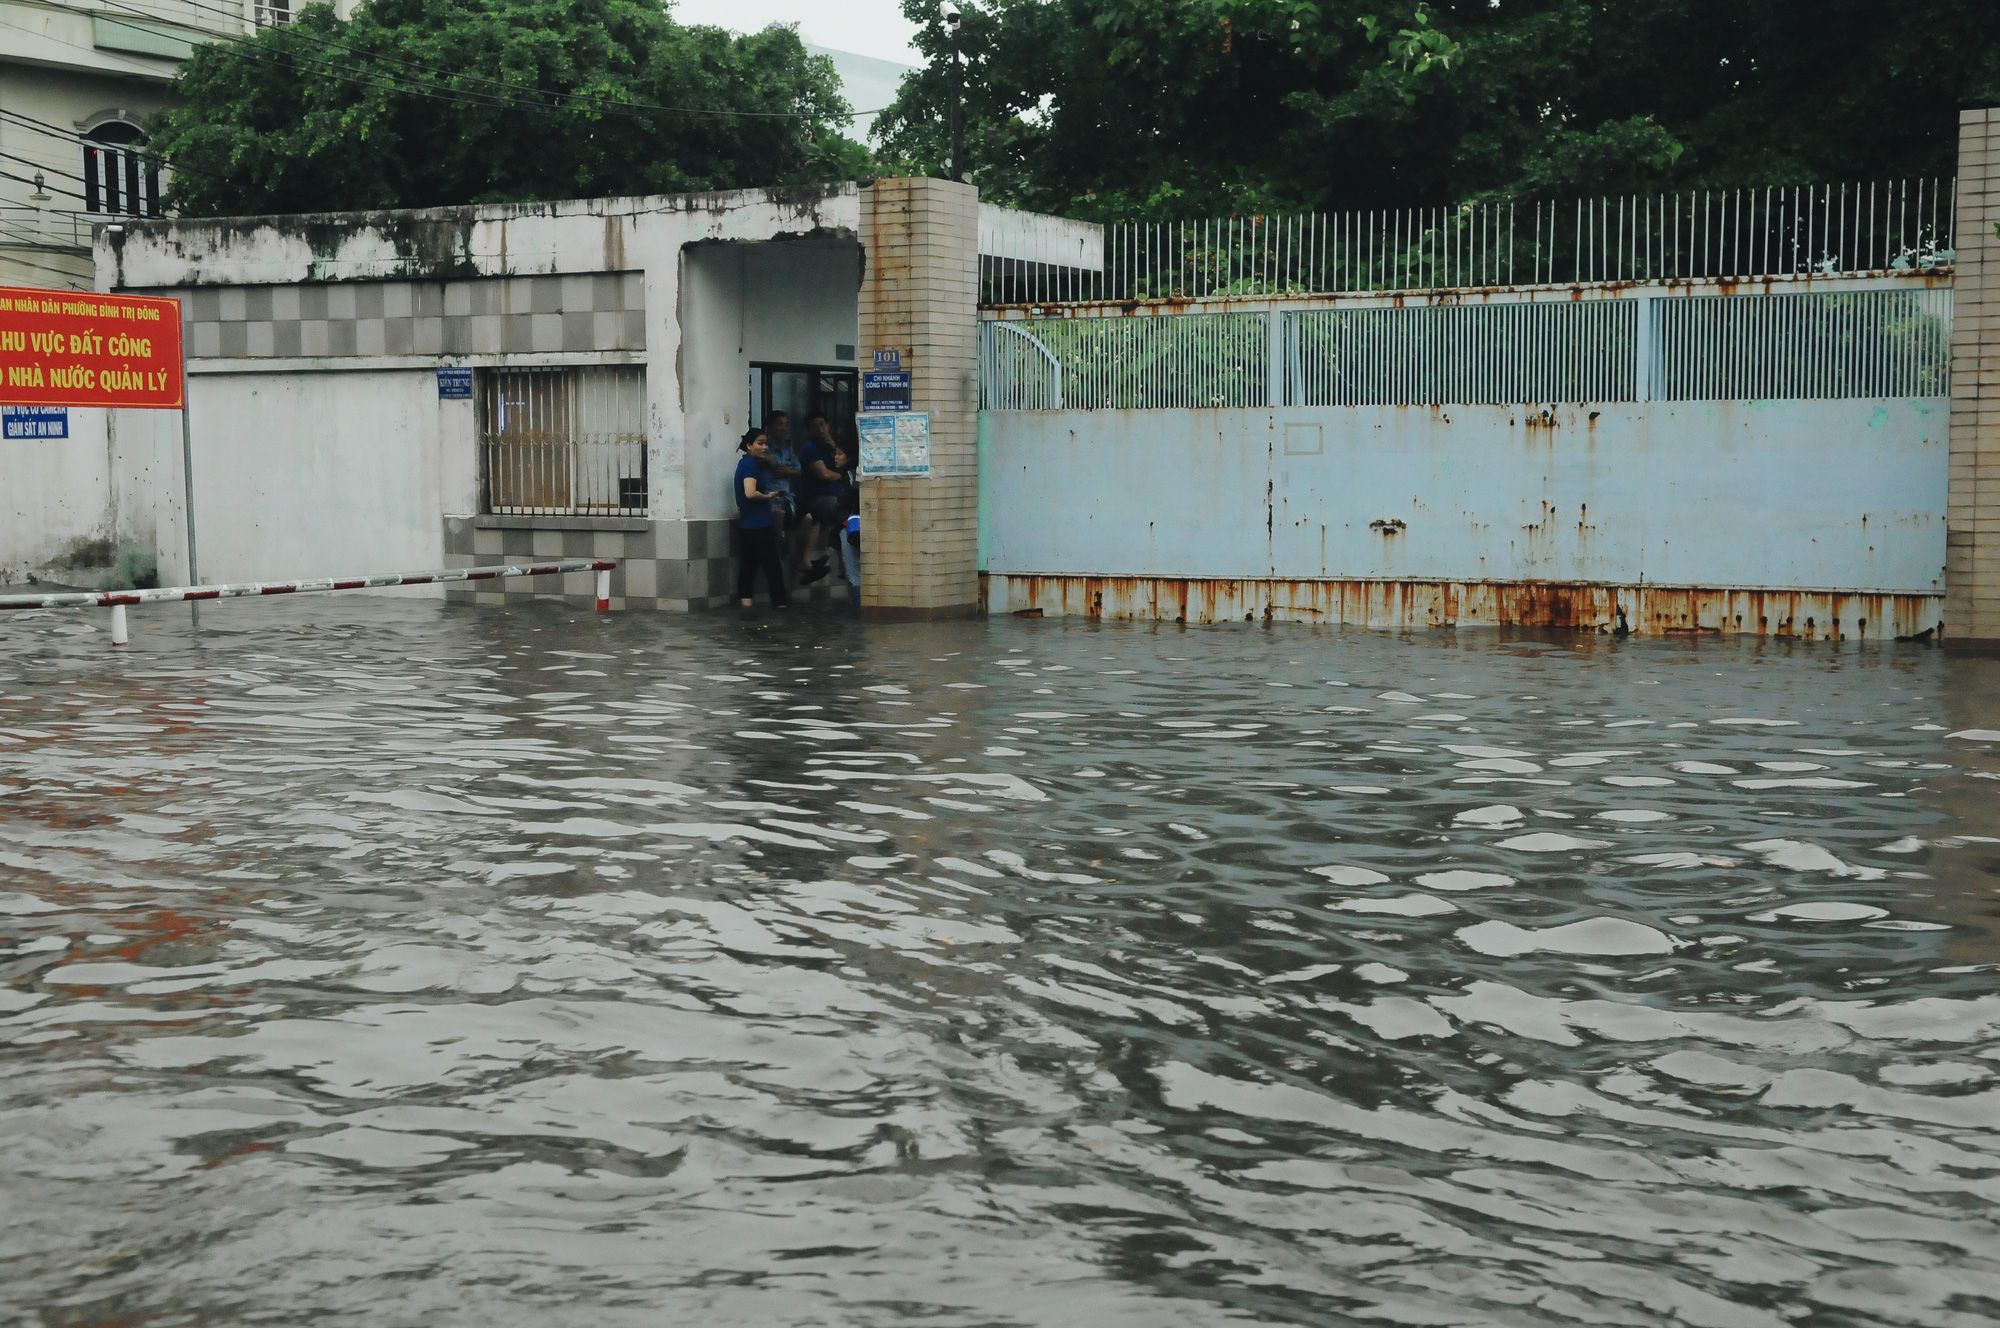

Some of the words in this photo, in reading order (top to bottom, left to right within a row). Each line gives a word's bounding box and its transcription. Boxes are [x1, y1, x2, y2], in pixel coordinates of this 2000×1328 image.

[14, 297, 39, 313] NHÂN
[42, 298, 60, 314] DÂN
[62, 300, 97, 317] PHƯỜNG
[100, 302, 119, 318] BÌNH
[121, 306, 135, 322] TRỊ
[137, 305, 160, 321] ĐÔNG
[0, 330, 25, 352] HU
[30, 330, 65, 357] VỰC
[70, 328, 103, 355] ĐẤT
[108, 332, 152, 358] CÔNG
[877, 351, 897, 362] 101
[8, 362, 45, 388] NHÀ
[50, 364, 95, 389] NƯỚC
[100, 364, 143, 393] QUẢN
[148, 367, 168, 392] LÝ
[7, 418, 24, 437] GIÁM
[24, 418, 37, 436] SÁT
[37, 421, 47, 436] AN
[47, 421, 63, 436] NINH
